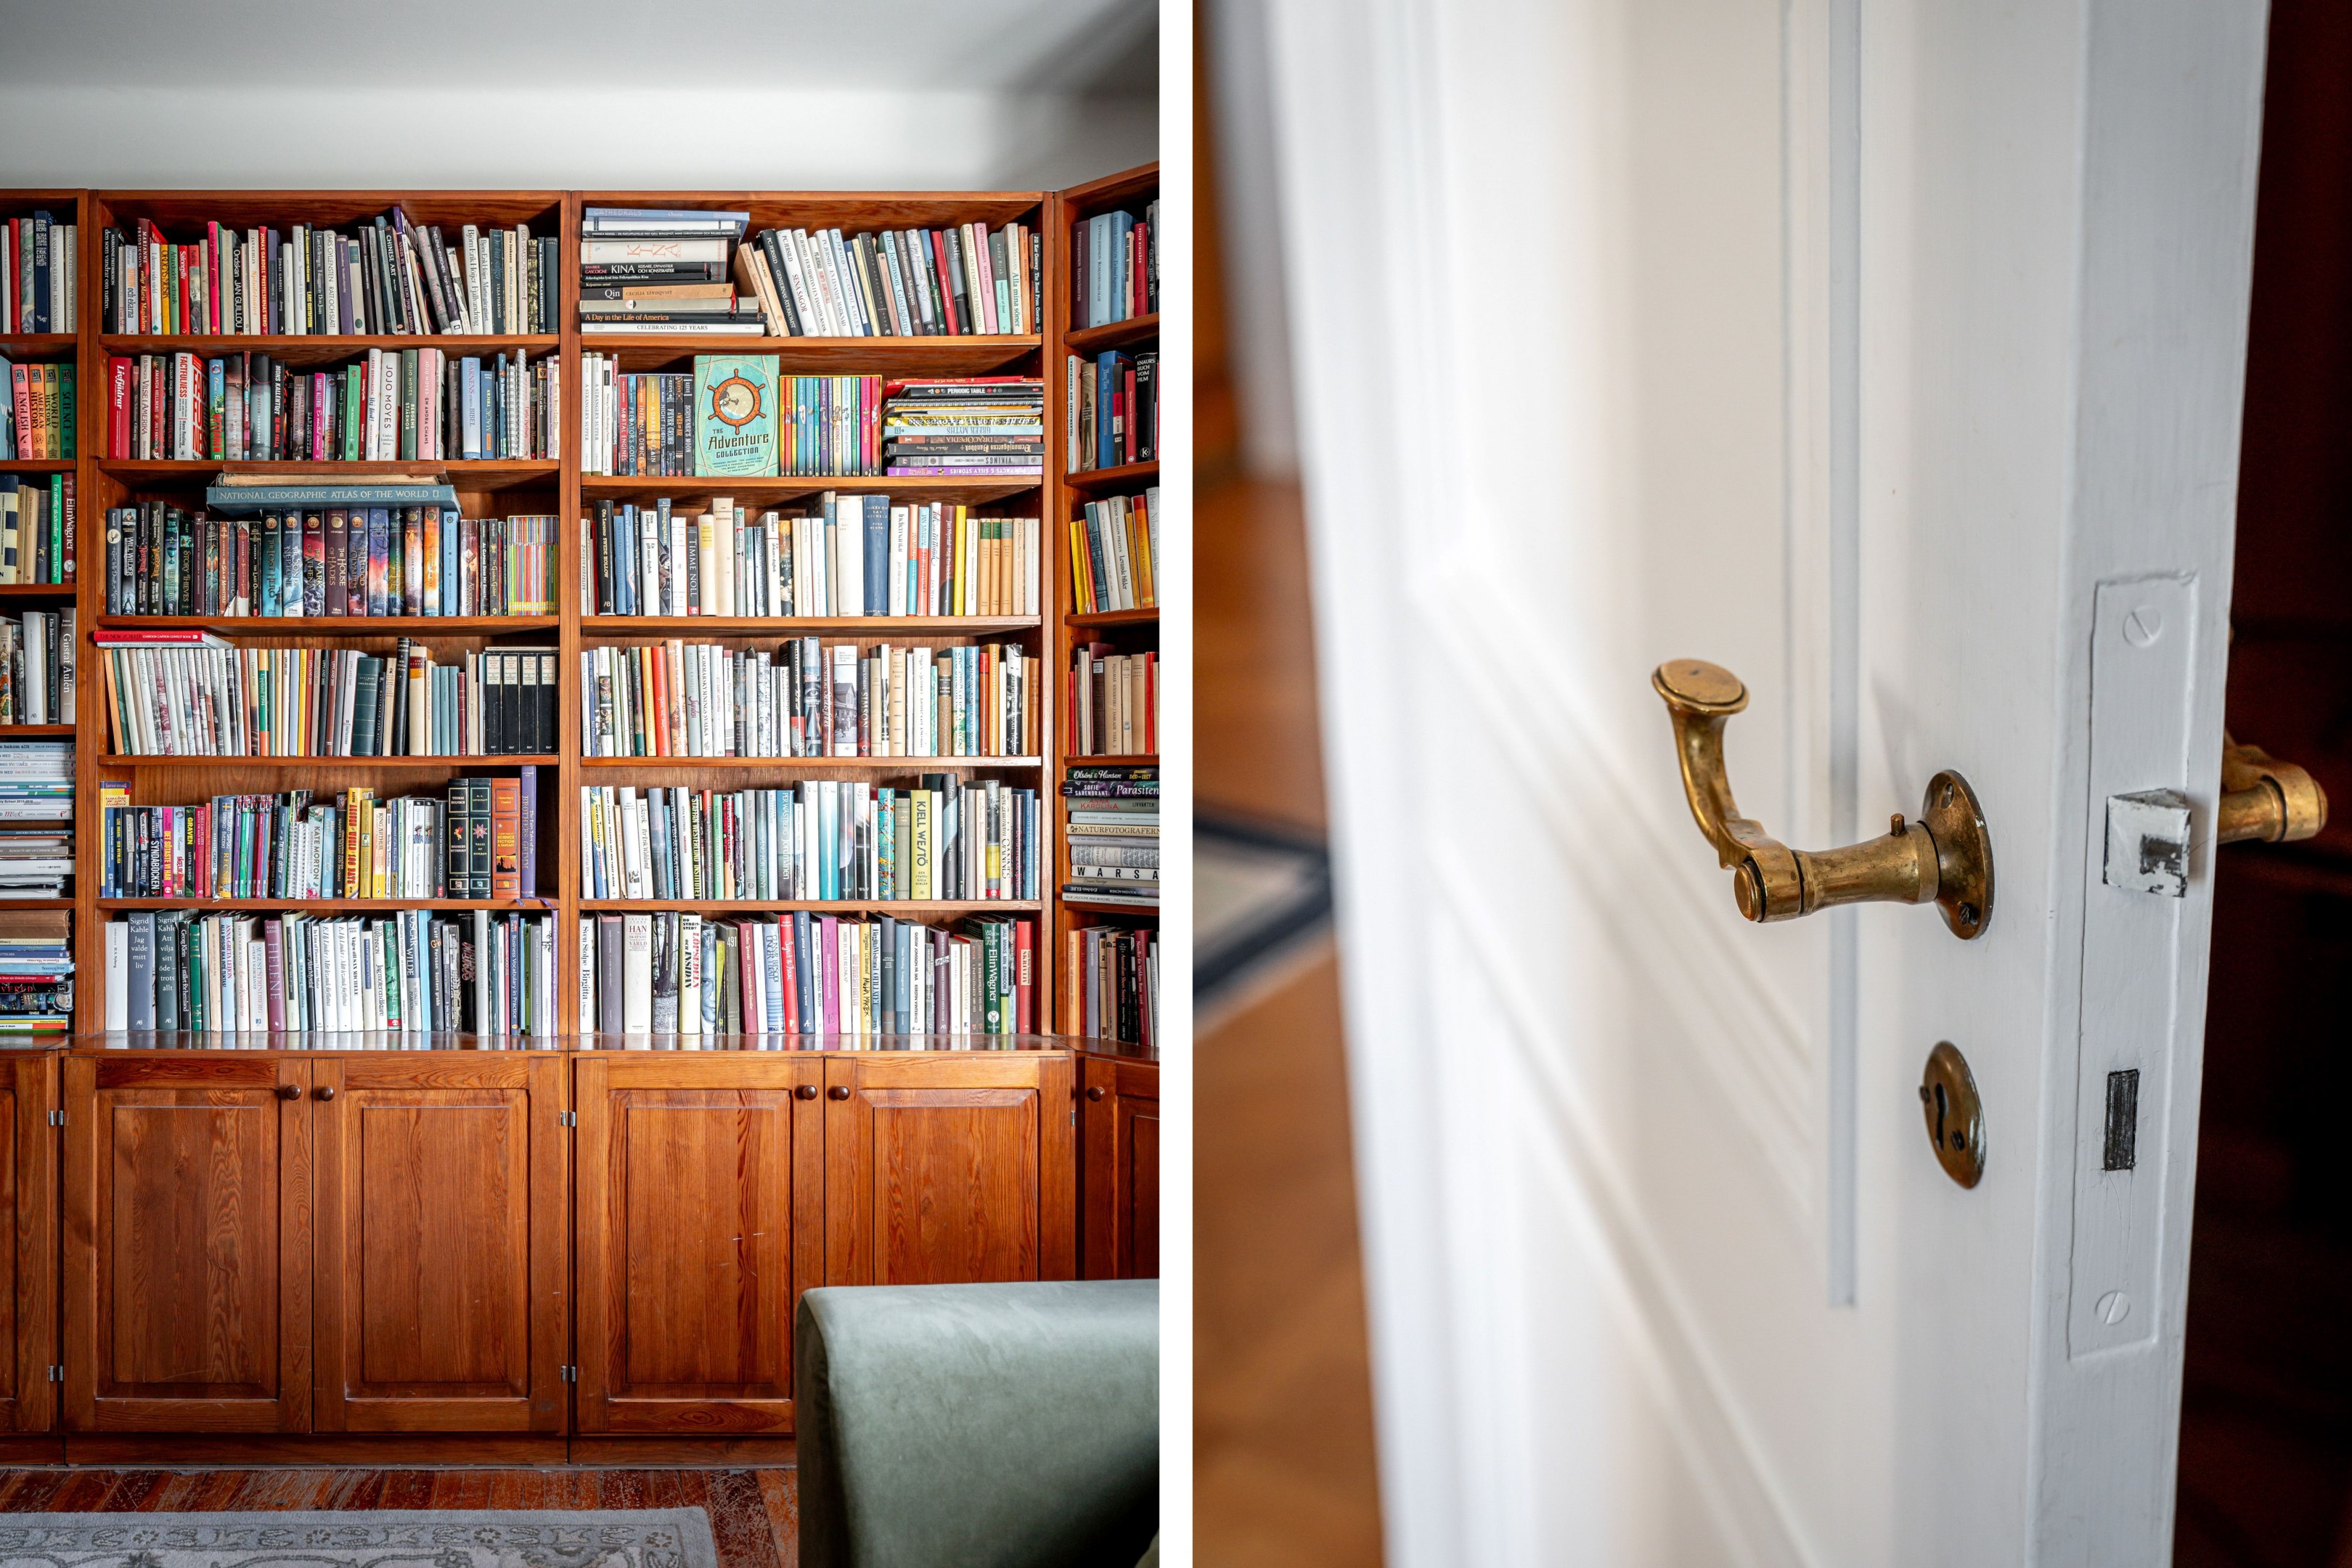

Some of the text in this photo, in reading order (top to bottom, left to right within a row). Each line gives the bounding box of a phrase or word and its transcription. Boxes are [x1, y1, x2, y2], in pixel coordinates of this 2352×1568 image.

[889, 252, 901, 286] Johansson
[605, 290, 620, 299] Qin
[792, 274, 807, 312] SENA SAGOR
[115, 365, 124, 409] Livfjädrar
[19, 392, 28, 430] ENGLISH
[62, 392, 72, 433] SCIENCE
[709, 433, 769, 450] Adventure
[716, 447, 759, 458] COLLECTION
[330, 547, 333, 556] OF
[338, 558, 346, 586] HOUSE
[1116, 786, 1159, 795] Parasiten
[917, 801, 926, 828] KJELL
[727, 936, 736, 947] 491
[268, 943, 281, 1000] HELENE
[988, 967, 997, 1003] Wägner
